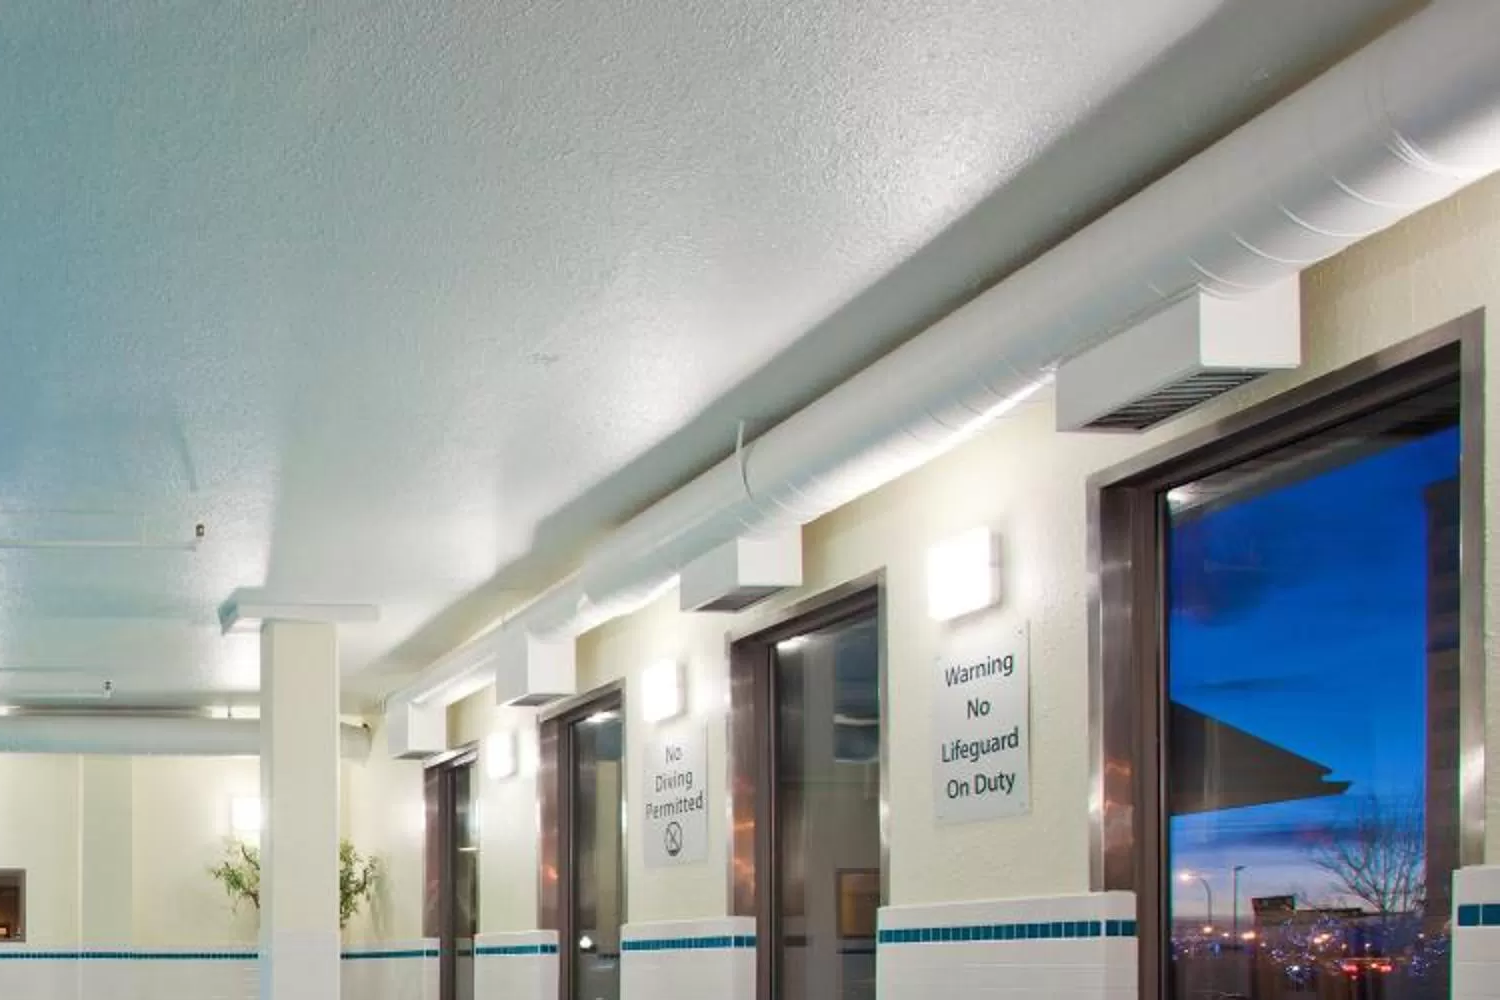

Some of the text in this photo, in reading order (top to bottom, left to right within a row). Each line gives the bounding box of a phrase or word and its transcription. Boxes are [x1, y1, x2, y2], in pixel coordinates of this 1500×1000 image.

[945, 654, 1013, 687] Warning
[967, 697, 990, 720] No
[941, 726, 1019, 763] Lifeguard
[655, 770, 693, 793] Diving
[947, 772, 1016, 799] On Duty
[645, 789, 703, 820] Permitted
